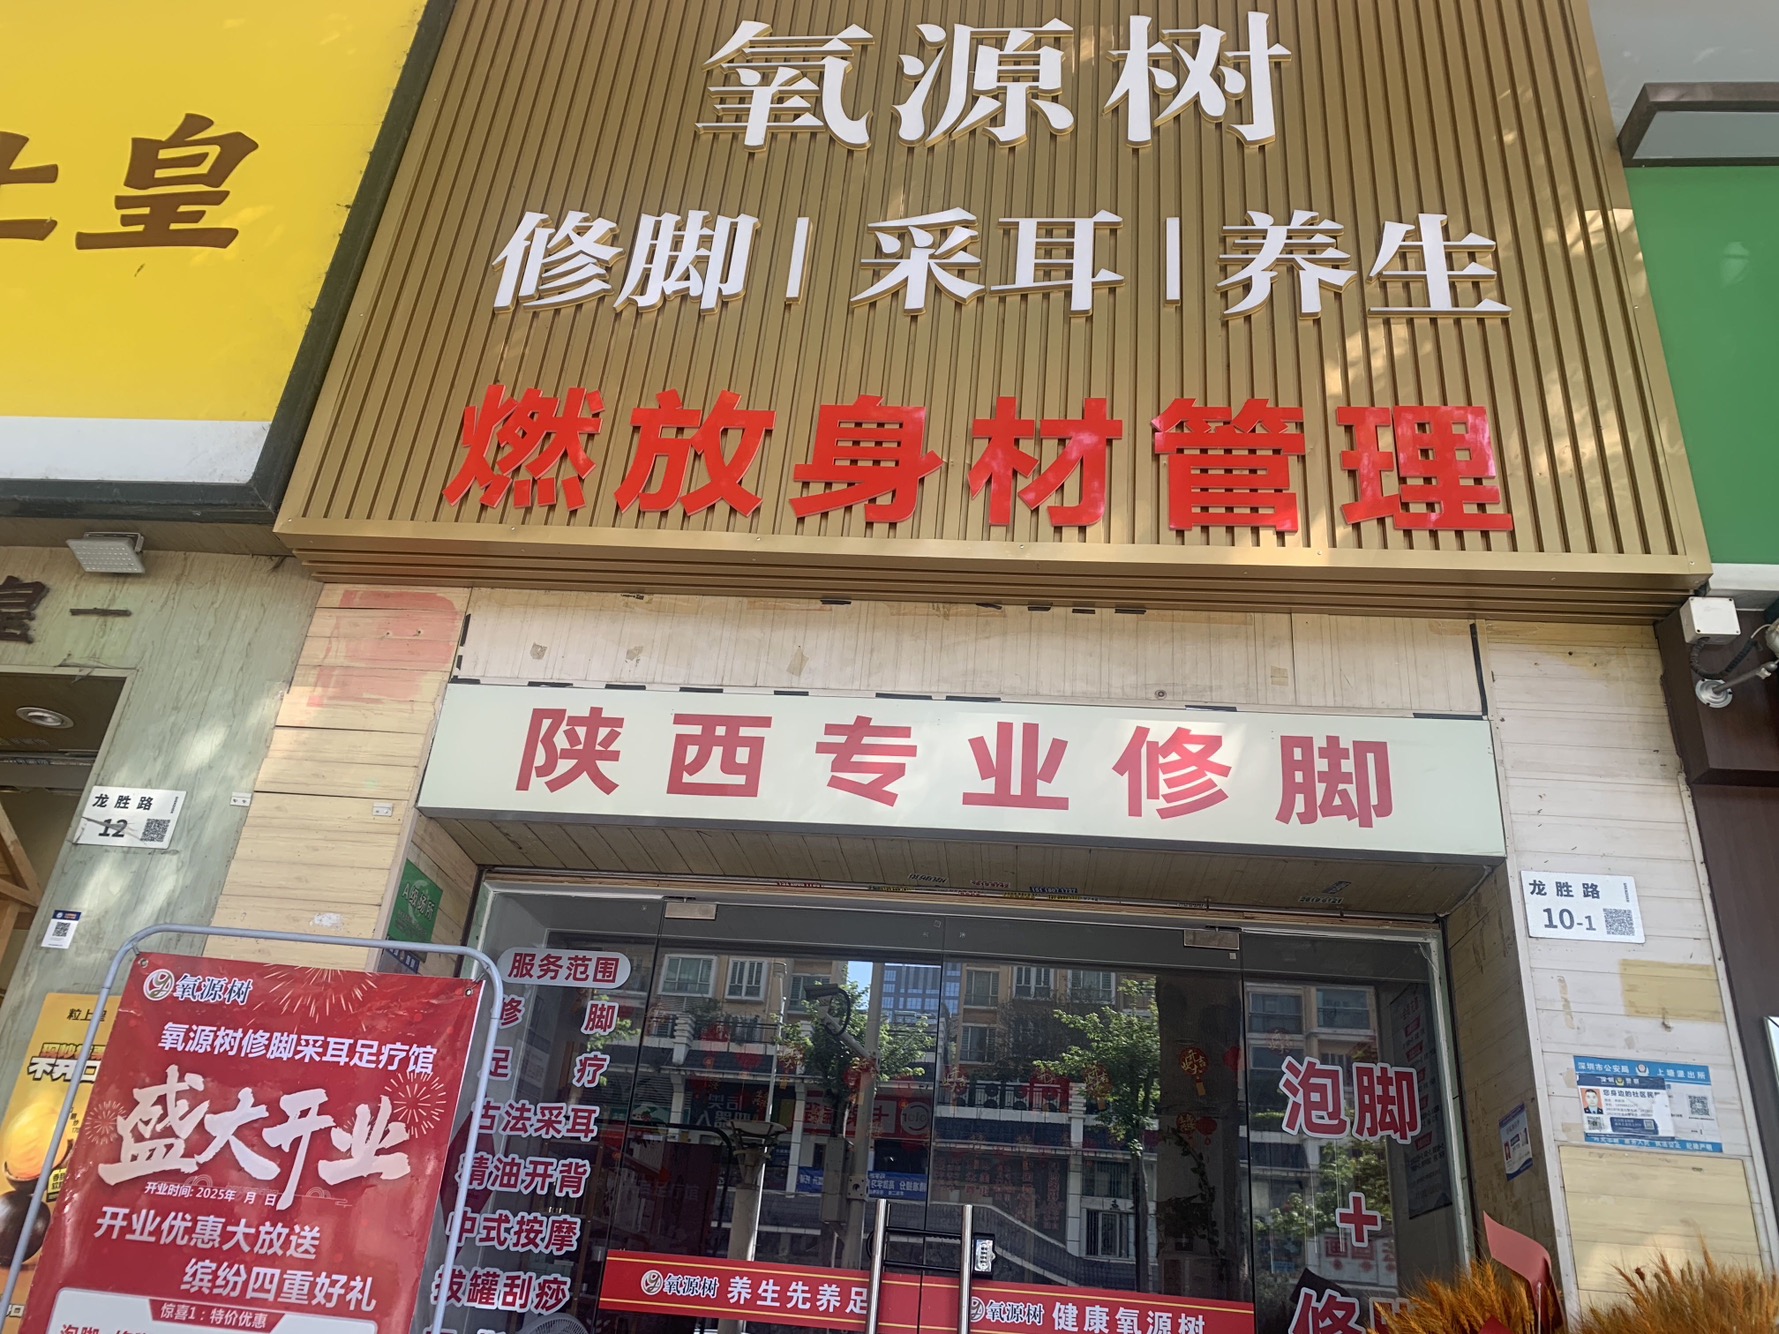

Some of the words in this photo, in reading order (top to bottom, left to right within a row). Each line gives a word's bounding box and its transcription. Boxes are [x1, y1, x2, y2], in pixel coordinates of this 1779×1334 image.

[695, 12, 1291, 151] 氧源树
[443, 384, 1512, 532] 燃放身材管理
[517, 708, 1392, 829] 陕西专业修脚
[92, 793, 154, 811] 龙胜路
[98, 818, 128, 838] 12
[1529, 879, 1600, 899] 龙胜路
[1542, 907, 1597, 930] 10-1
[508, 952, 620, 983] 服务范围
[172, 973, 253, 1004] 氧源树
[157, 1021, 438, 1074] 氧源树修脚采耳足疗馆
[1577, 1061, 1630, 1074] 深圳市公安局
[478, 1100, 597, 1139] 古法采耳
[1282, 1059, 1418, 1141] 泡脚
[98, 1064, 411, 1210] 盛大开业
[195, 1186, 237, 1202] 2025年
[94, 1206, 321, 1260] 开业优惠大放送
[180, 1257, 377, 1311] 缤纷四重好礼
[663, 1273, 719, 1298] 氧源树
[727, 1276, 868, 1314] 养生先养足
[985, 1300, 1045, 1325] 氧源树
[1052, 1301, 1206, 1334] 健康氧源树
